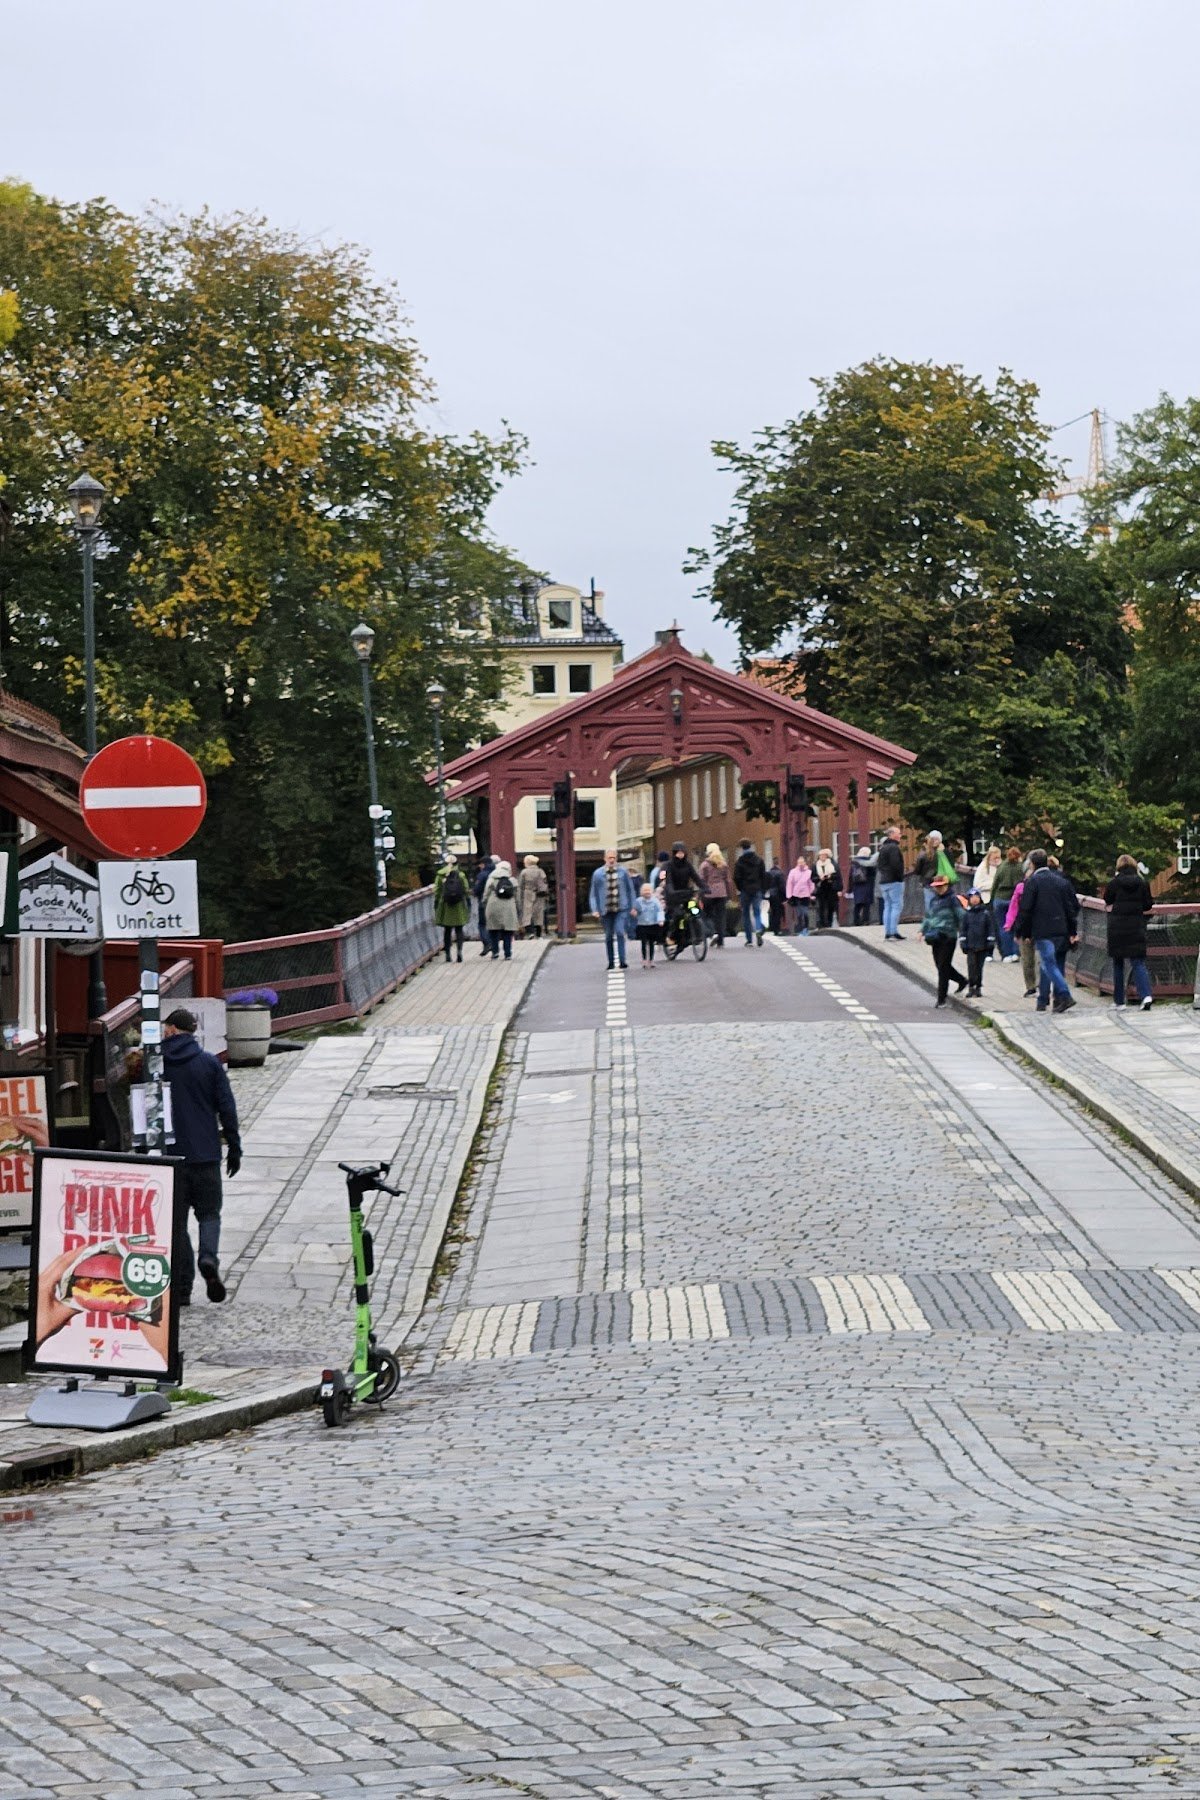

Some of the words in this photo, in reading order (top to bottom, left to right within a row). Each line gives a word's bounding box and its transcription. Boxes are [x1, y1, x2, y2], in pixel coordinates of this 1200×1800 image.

[33, 896, 65, 908] Gode
[67, 900, 94, 924] Nabo
[116, 914, 183, 930] Unntatt
[65, 1184, 157, 1235] PINK
